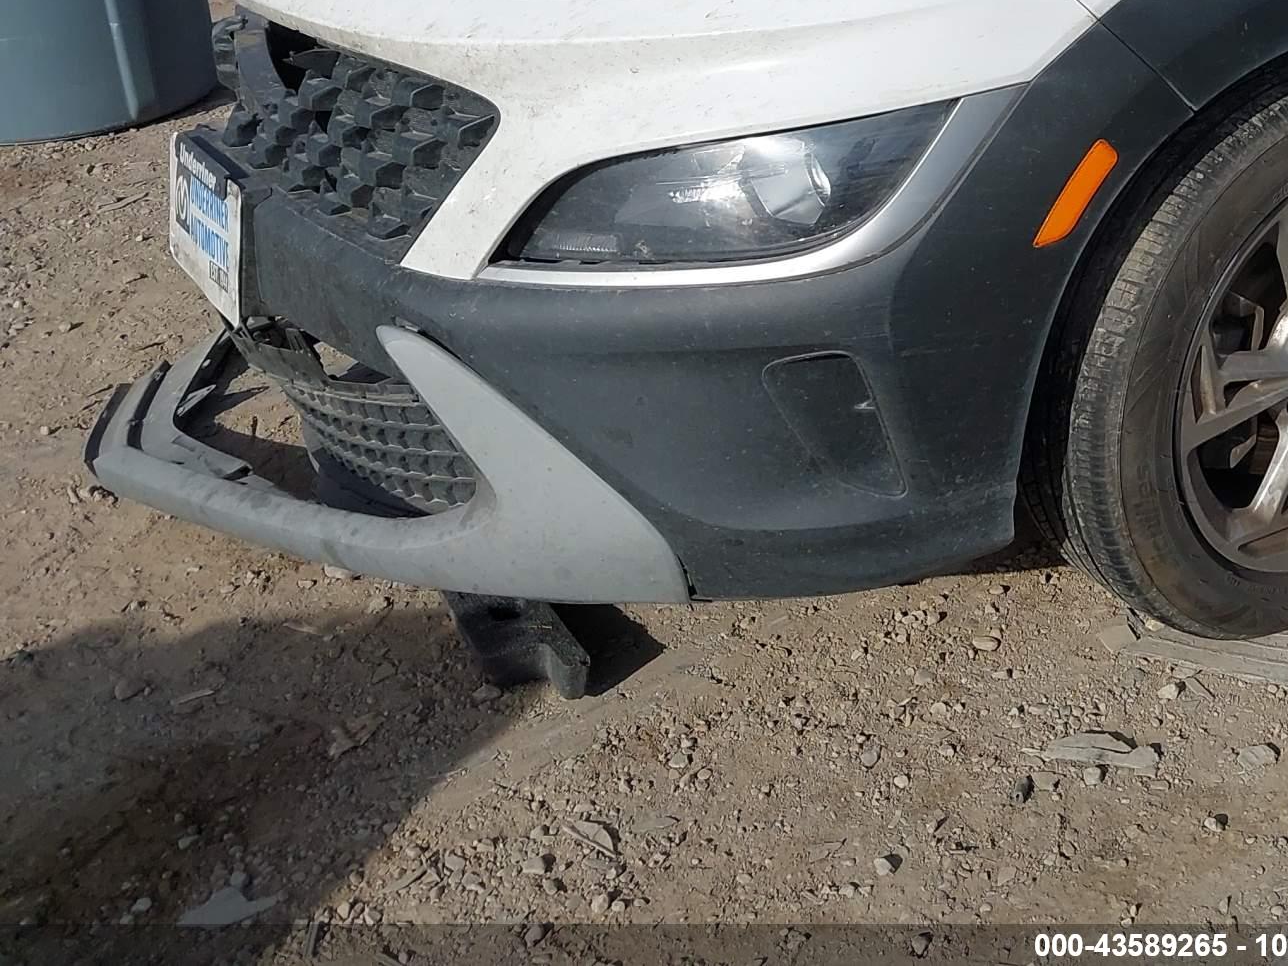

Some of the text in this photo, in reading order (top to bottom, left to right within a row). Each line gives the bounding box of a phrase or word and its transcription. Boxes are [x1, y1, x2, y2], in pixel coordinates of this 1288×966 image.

[179, 142, 217, 190] Underriner
[191, 174, 229, 233] UNDERRINER
[190, 215, 229, 272] AUTOMOTIVE
